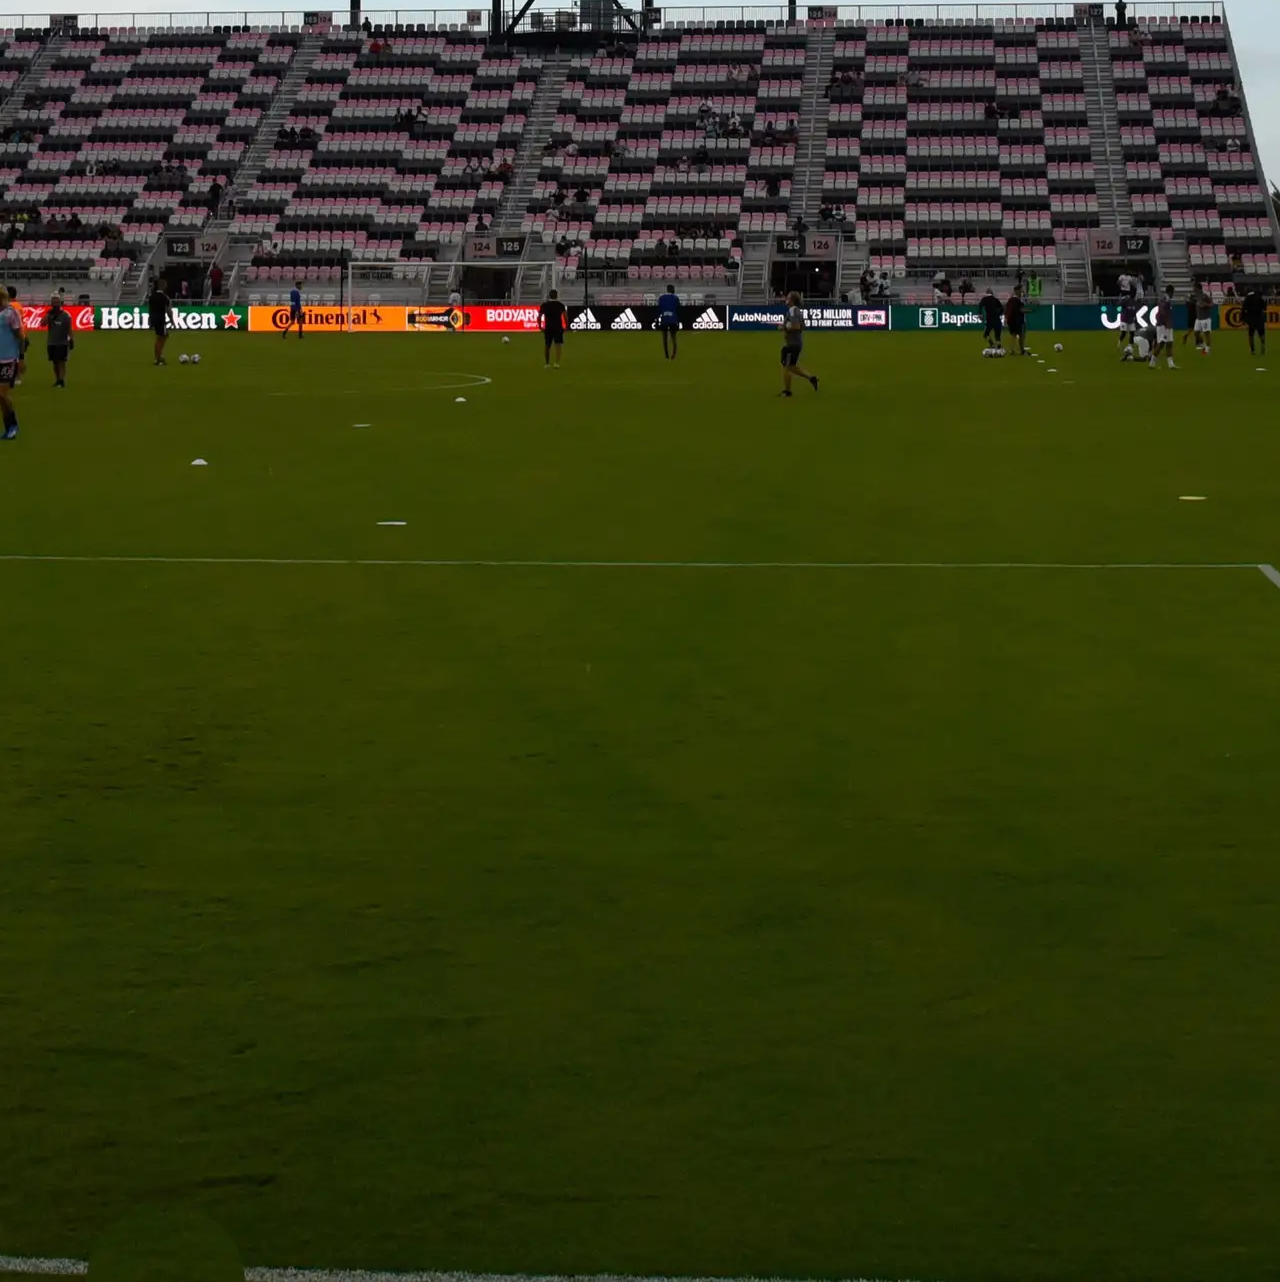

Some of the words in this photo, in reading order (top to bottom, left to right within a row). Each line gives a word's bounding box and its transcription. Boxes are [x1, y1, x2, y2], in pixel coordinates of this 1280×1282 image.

[172, 243, 189, 252] 123
[473, 242, 490, 251] 124
[502, 242, 520, 251] 125
[813, 240, 829, 250] 126
[1096, 240, 1113, 250] 126
[1126, 239, 1144, 250] 127
[732, 312, 784, 322] AutoNation
[823, 309, 852, 318] MILLION
[272, 309, 367, 329] Cotinental
[570, 321, 601, 329] adidas
[611, 321, 642, 329] adidas
[693, 321, 724, 329] adidas
